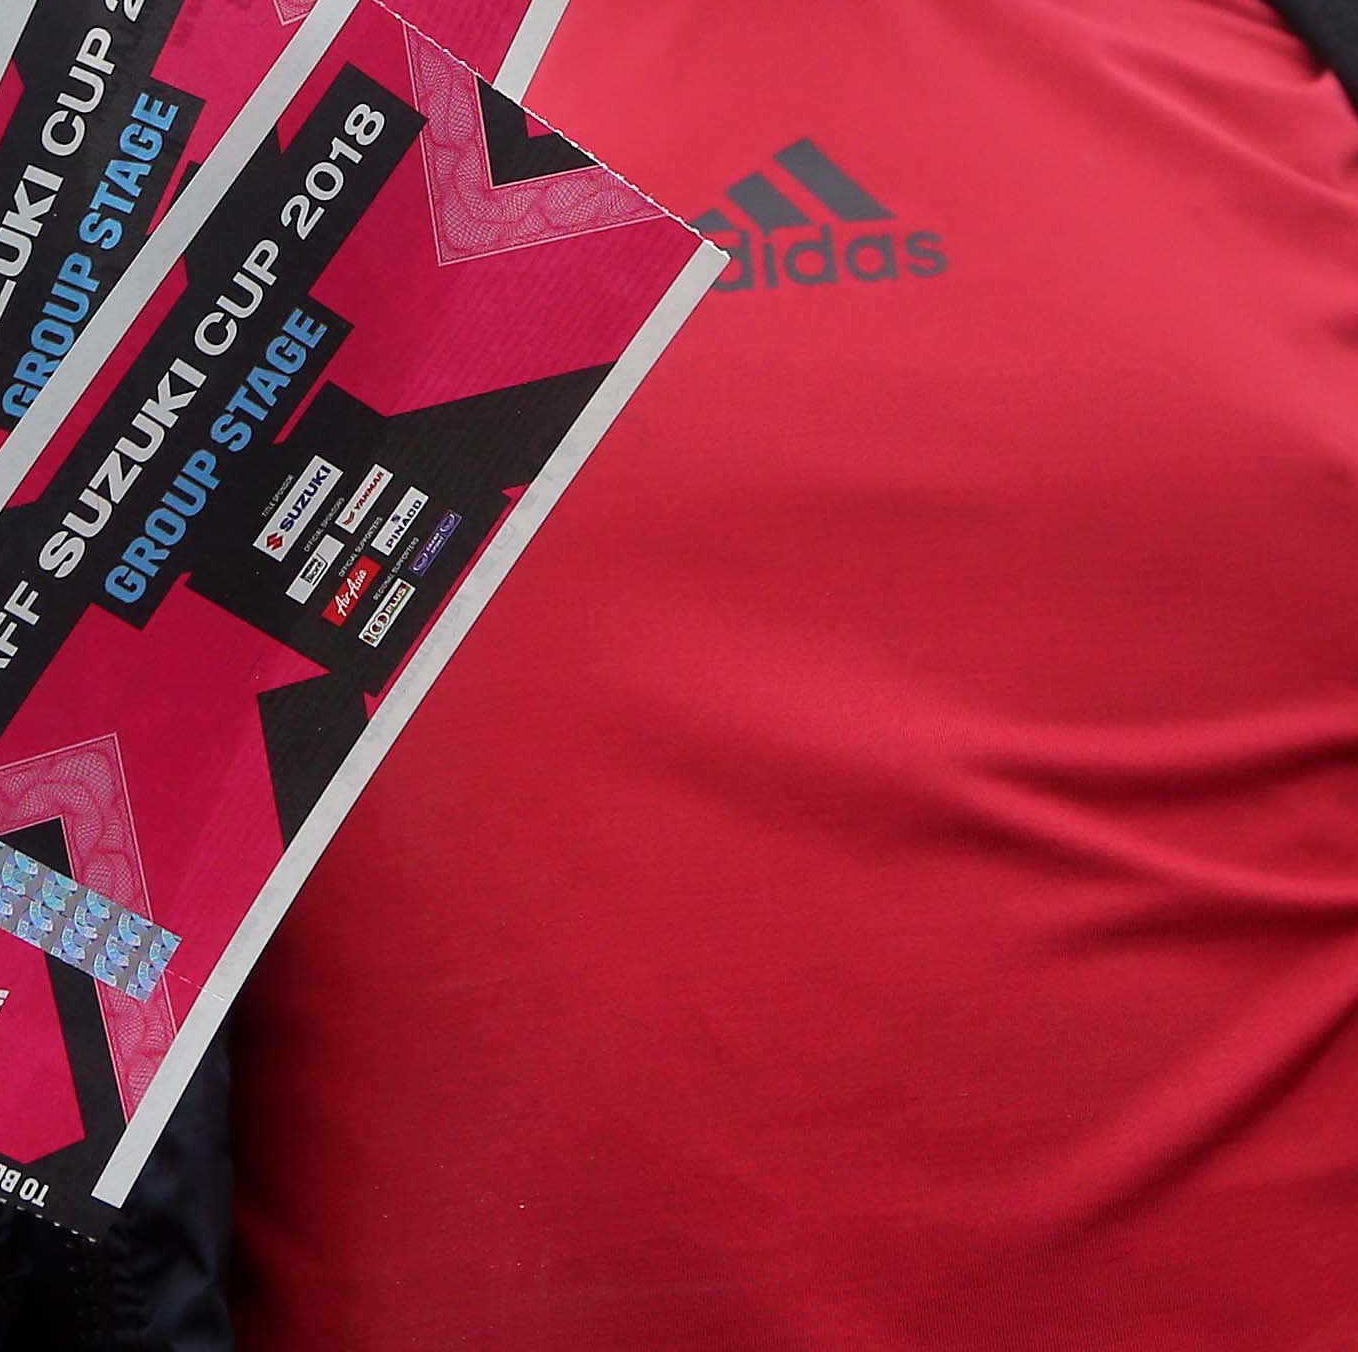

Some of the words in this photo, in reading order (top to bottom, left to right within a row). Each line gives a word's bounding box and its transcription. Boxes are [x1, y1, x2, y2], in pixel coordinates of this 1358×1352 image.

[41, 26, 118, 158] CUP
[1, 252, 102, 418] GROUP
[78, 92, 179, 251] STAGE
[711, 224, 948, 293] didas
[38, 357, 207, 579] SUZUKI
[194, 238, 282, 356] CUP
[280, 102, 386, 241] 2018
[104, 448, 220, 605] GROUP
[210, 307, 328, 453] STAGE
[279, 465, 331, 532] SUZUKI
[354, 471, 384, 510] YANMAR
[386, 499, 423, 549] PINACO
[334, 569, 367, 617] AirAsia
[18, 1177, 50, 1208] TO
